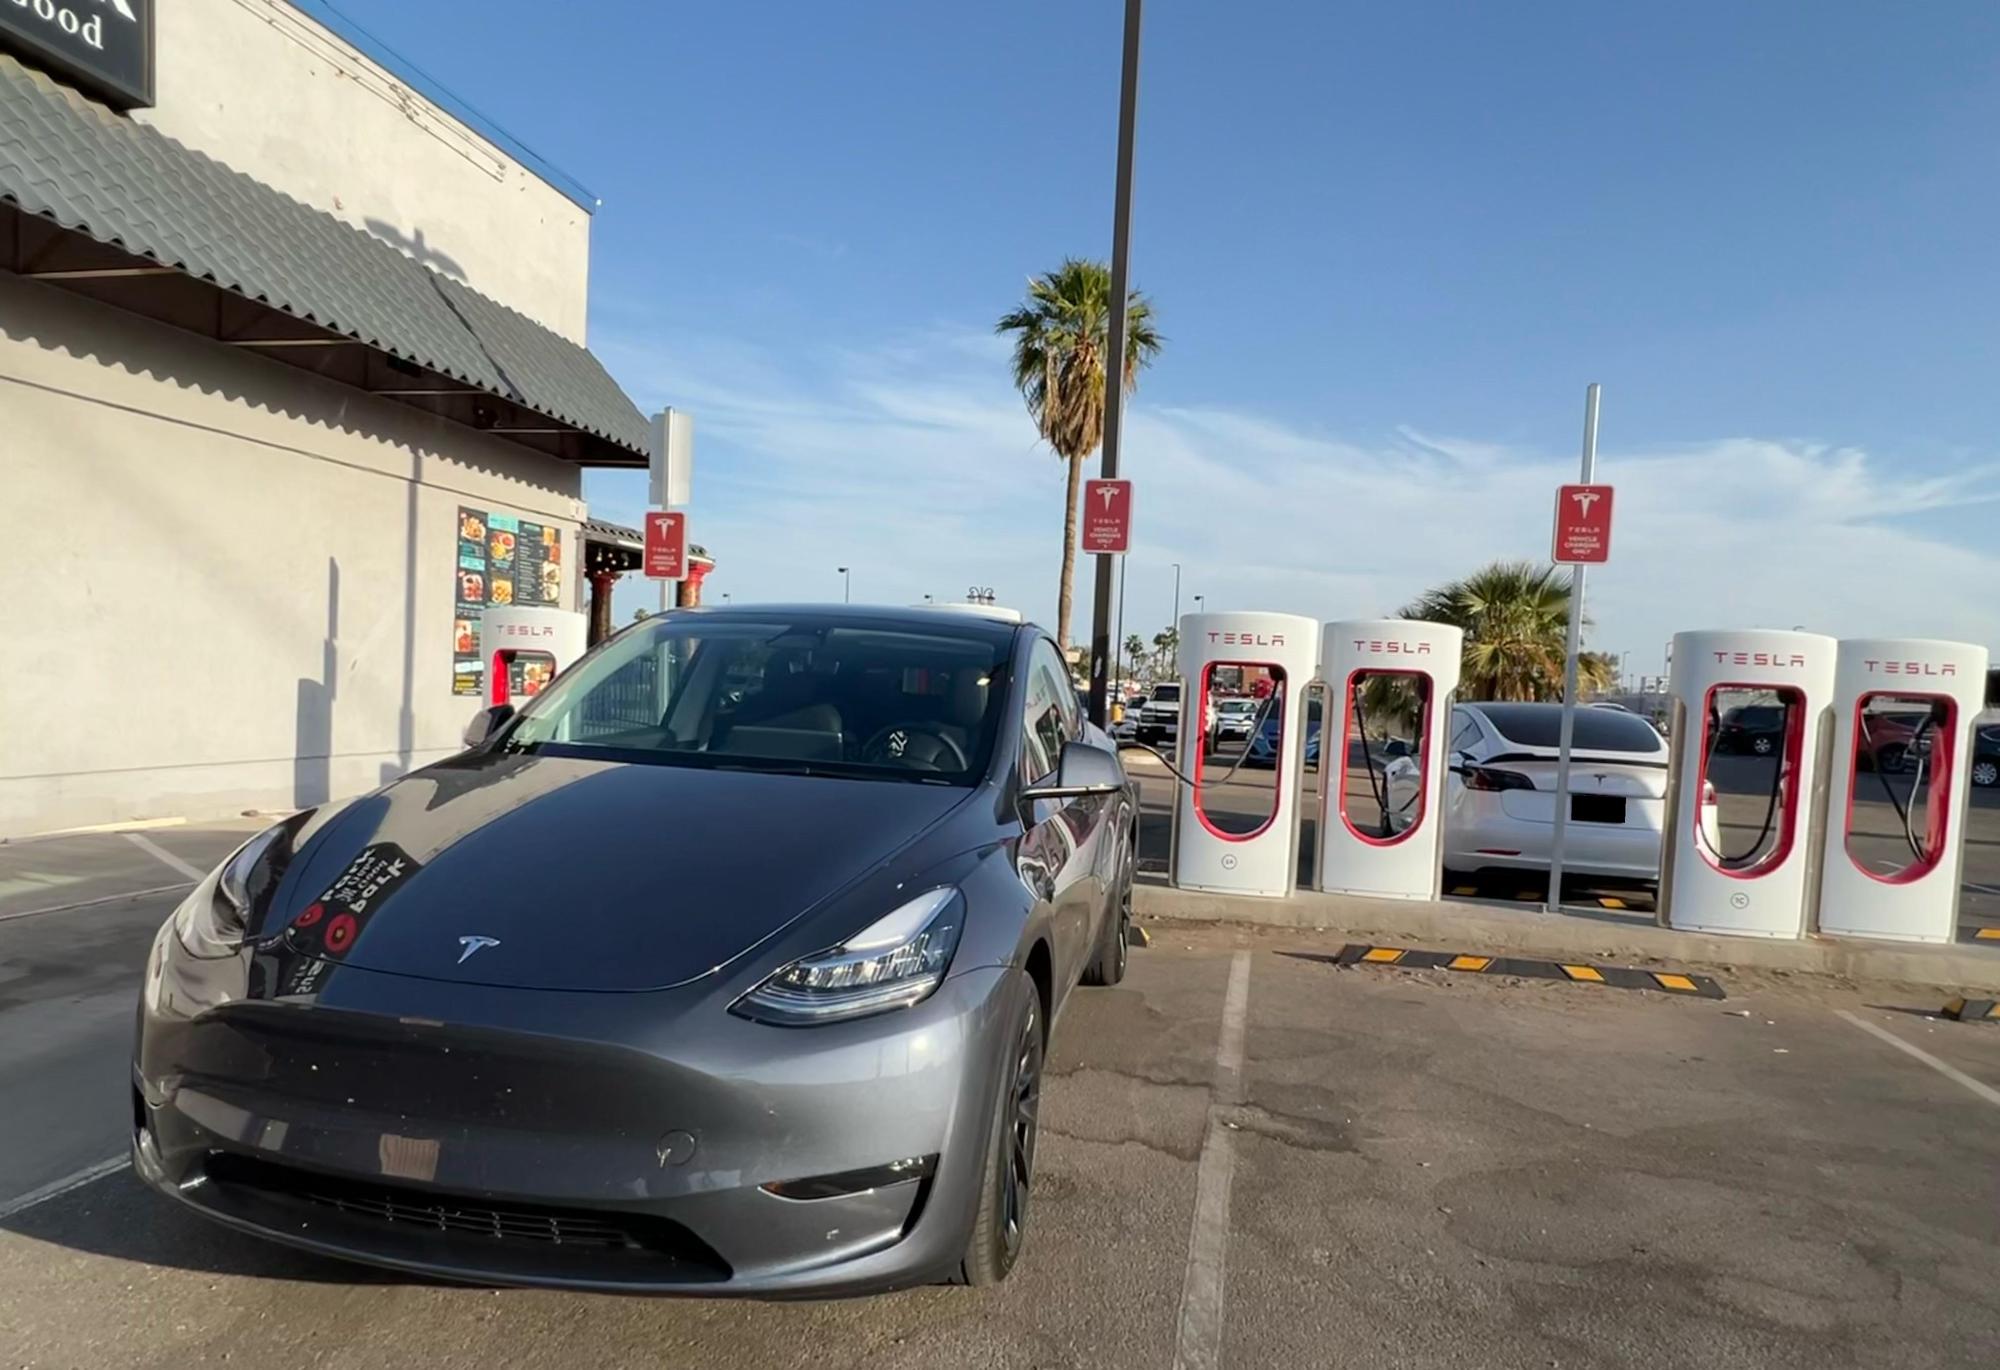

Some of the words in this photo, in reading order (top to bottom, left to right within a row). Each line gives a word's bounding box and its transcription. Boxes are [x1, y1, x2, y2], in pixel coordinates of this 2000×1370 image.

[7, 0, 104, 50] ood
[496, 625, 553, 636] TESLA
[1208, 632, 1285, 646] TESLA
[1354, 640, 1431, 654] TESLA
[1713, 652, 1804, 667] TESLA
[1864, 661, 1956, 675] TESLA
